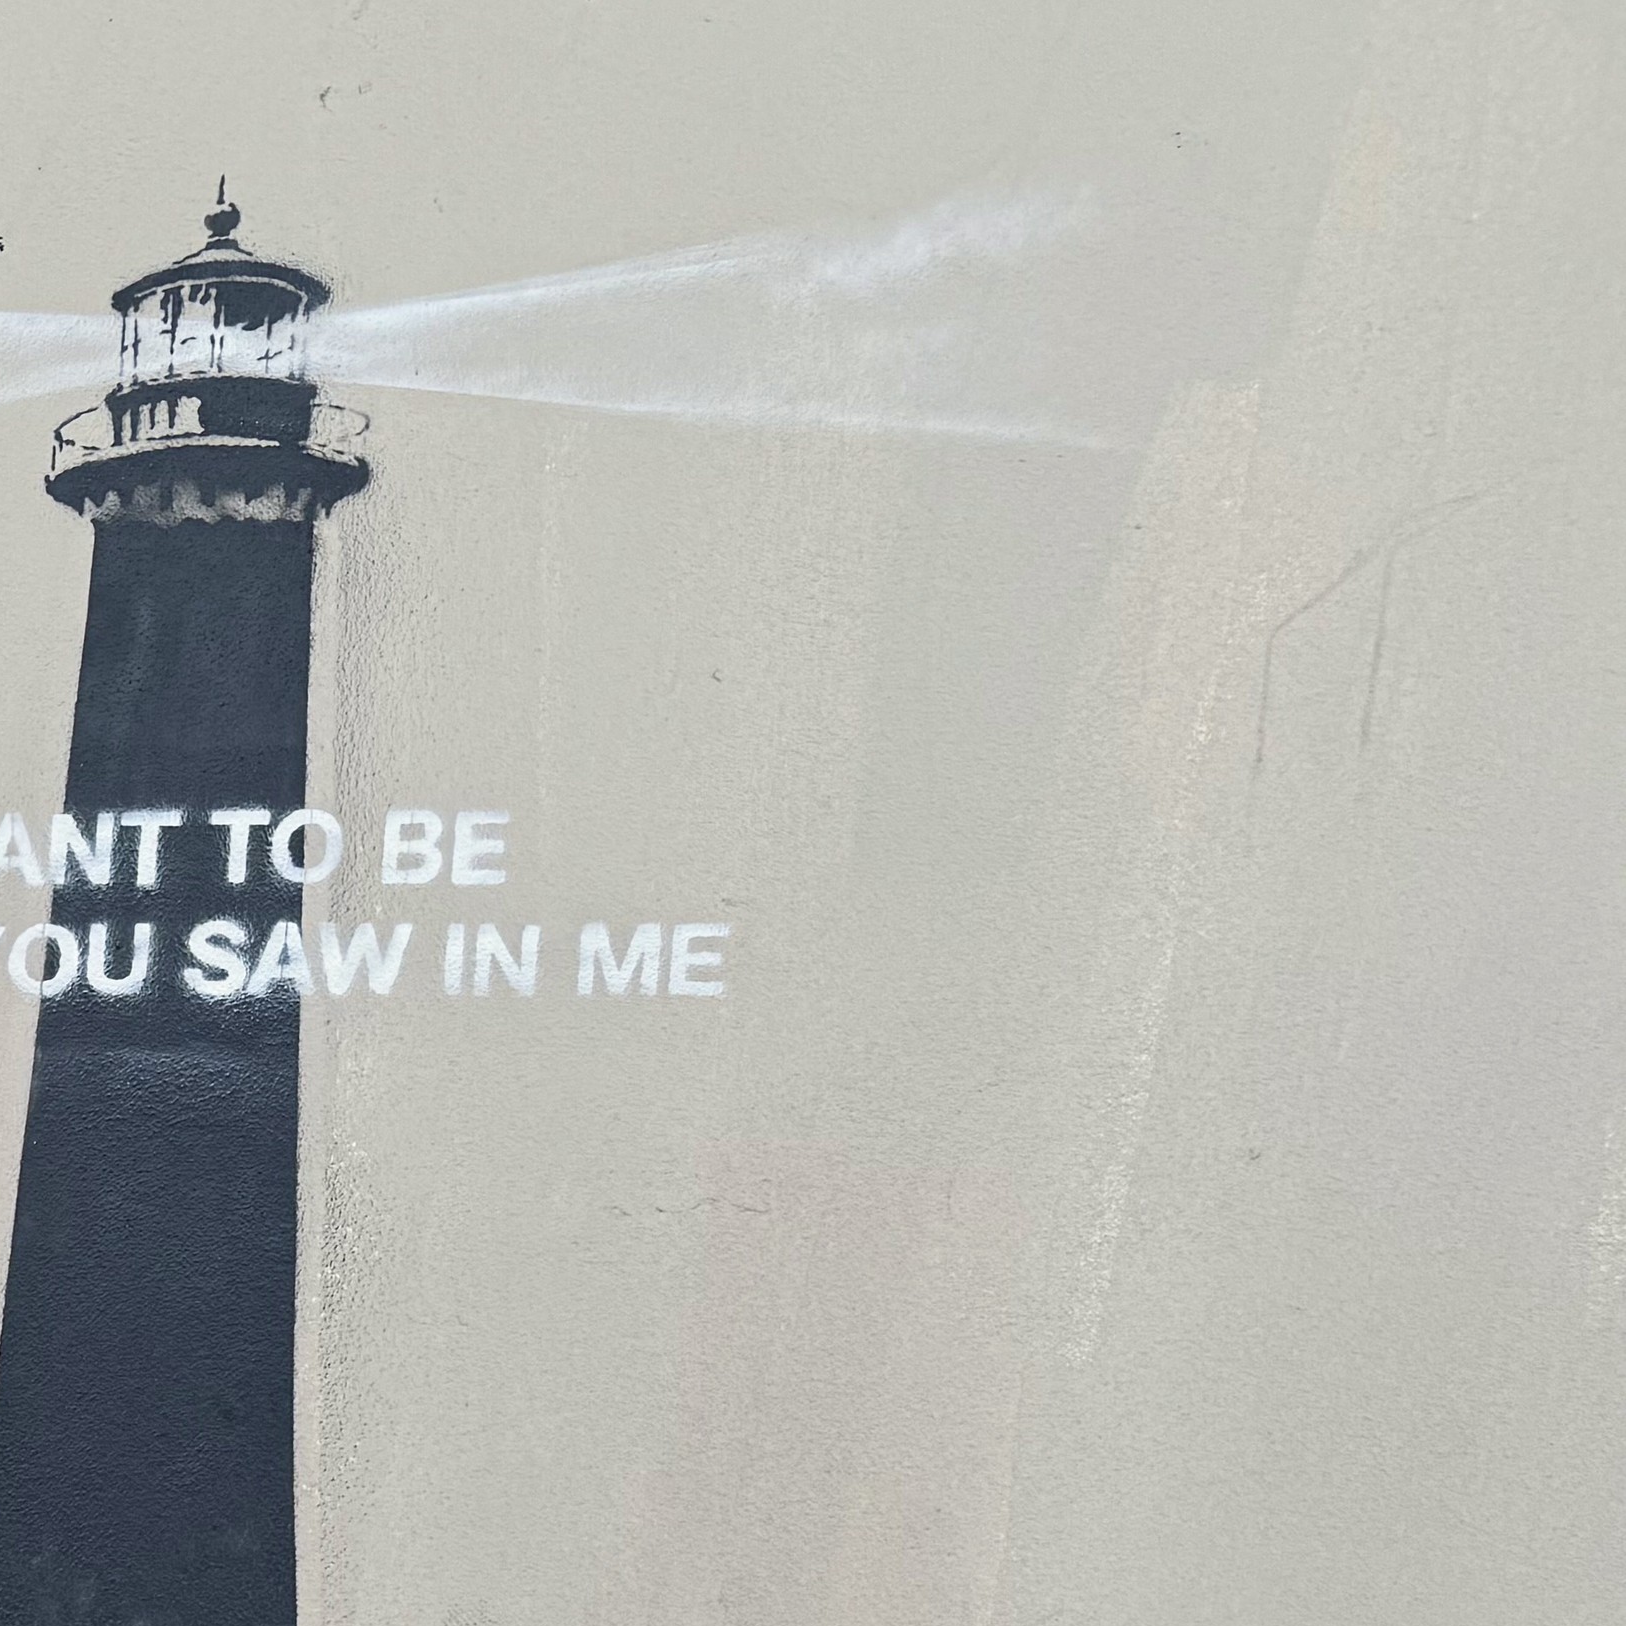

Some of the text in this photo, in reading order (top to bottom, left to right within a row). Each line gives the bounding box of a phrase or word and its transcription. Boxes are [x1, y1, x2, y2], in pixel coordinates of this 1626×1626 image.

[211, 807, 344, 885] TO
[381, 809, 510, 886] BE
[184, 919, 413, 997] SAW
[444, 922, 541, 997] IN
[576, 920, 731, 998] ME
